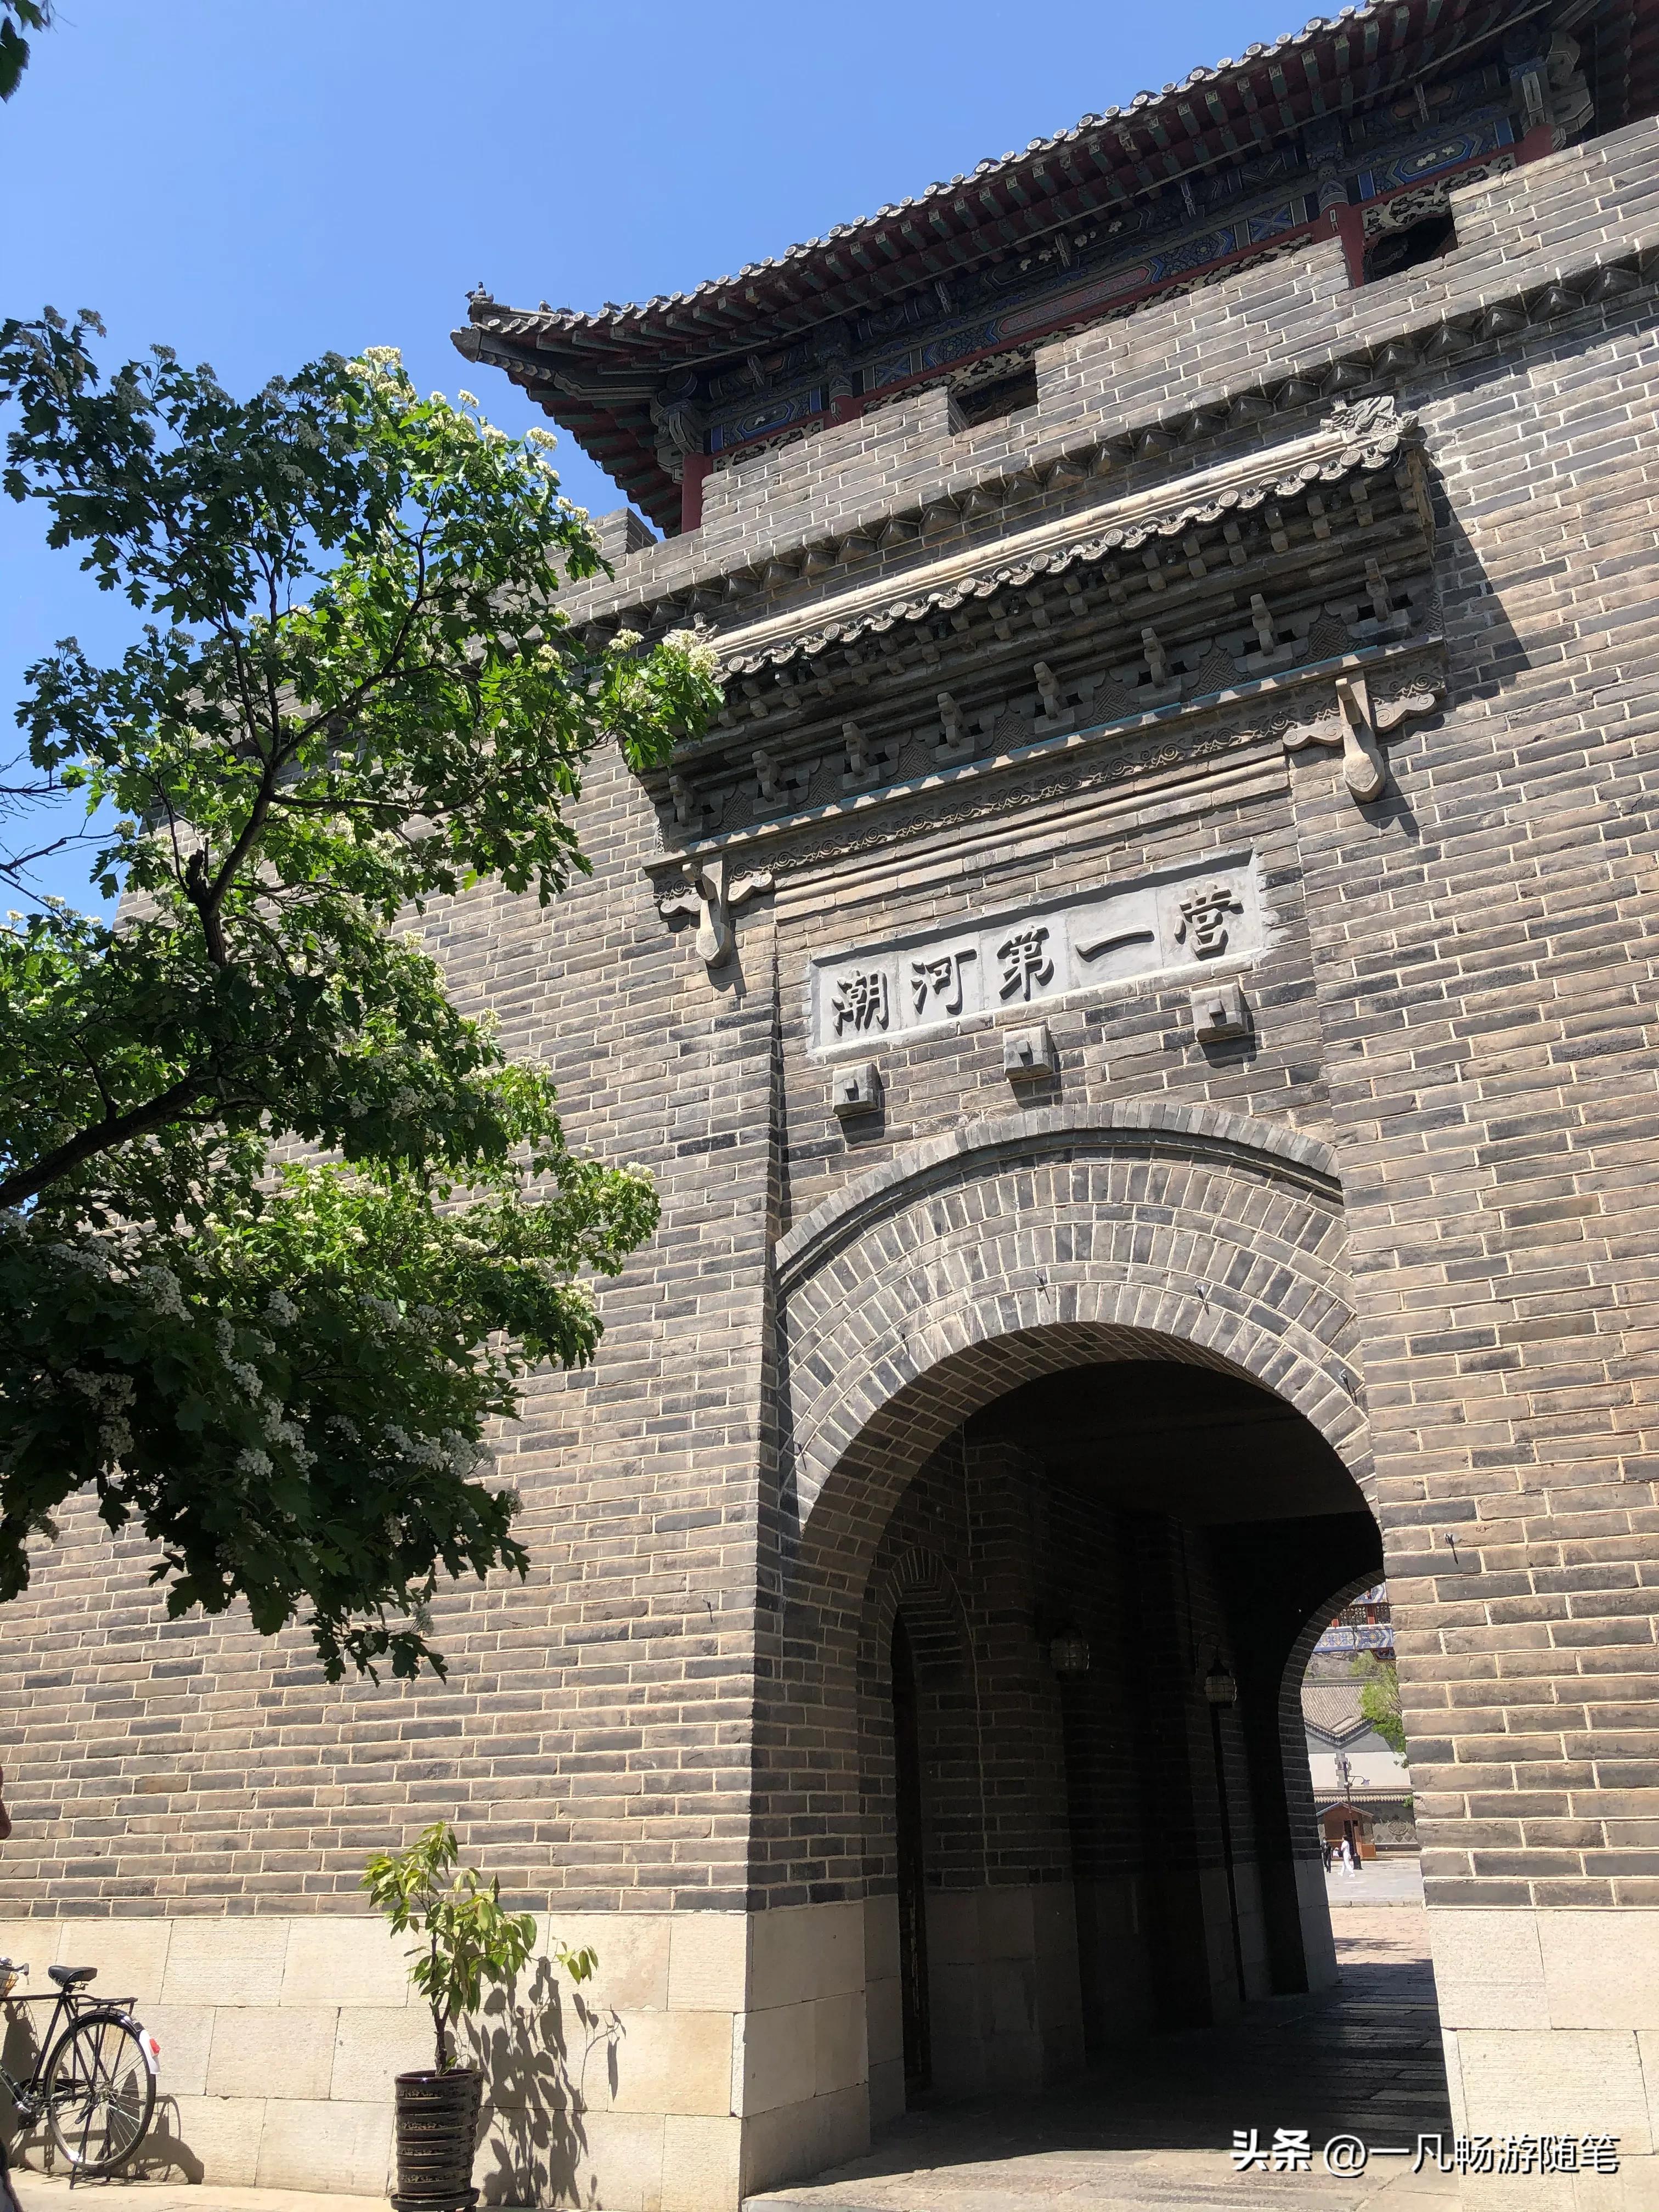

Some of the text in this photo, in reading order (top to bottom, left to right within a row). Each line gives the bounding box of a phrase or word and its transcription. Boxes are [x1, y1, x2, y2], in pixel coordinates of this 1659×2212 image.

[831, 881, 1244, 1036] 潮河第一营
